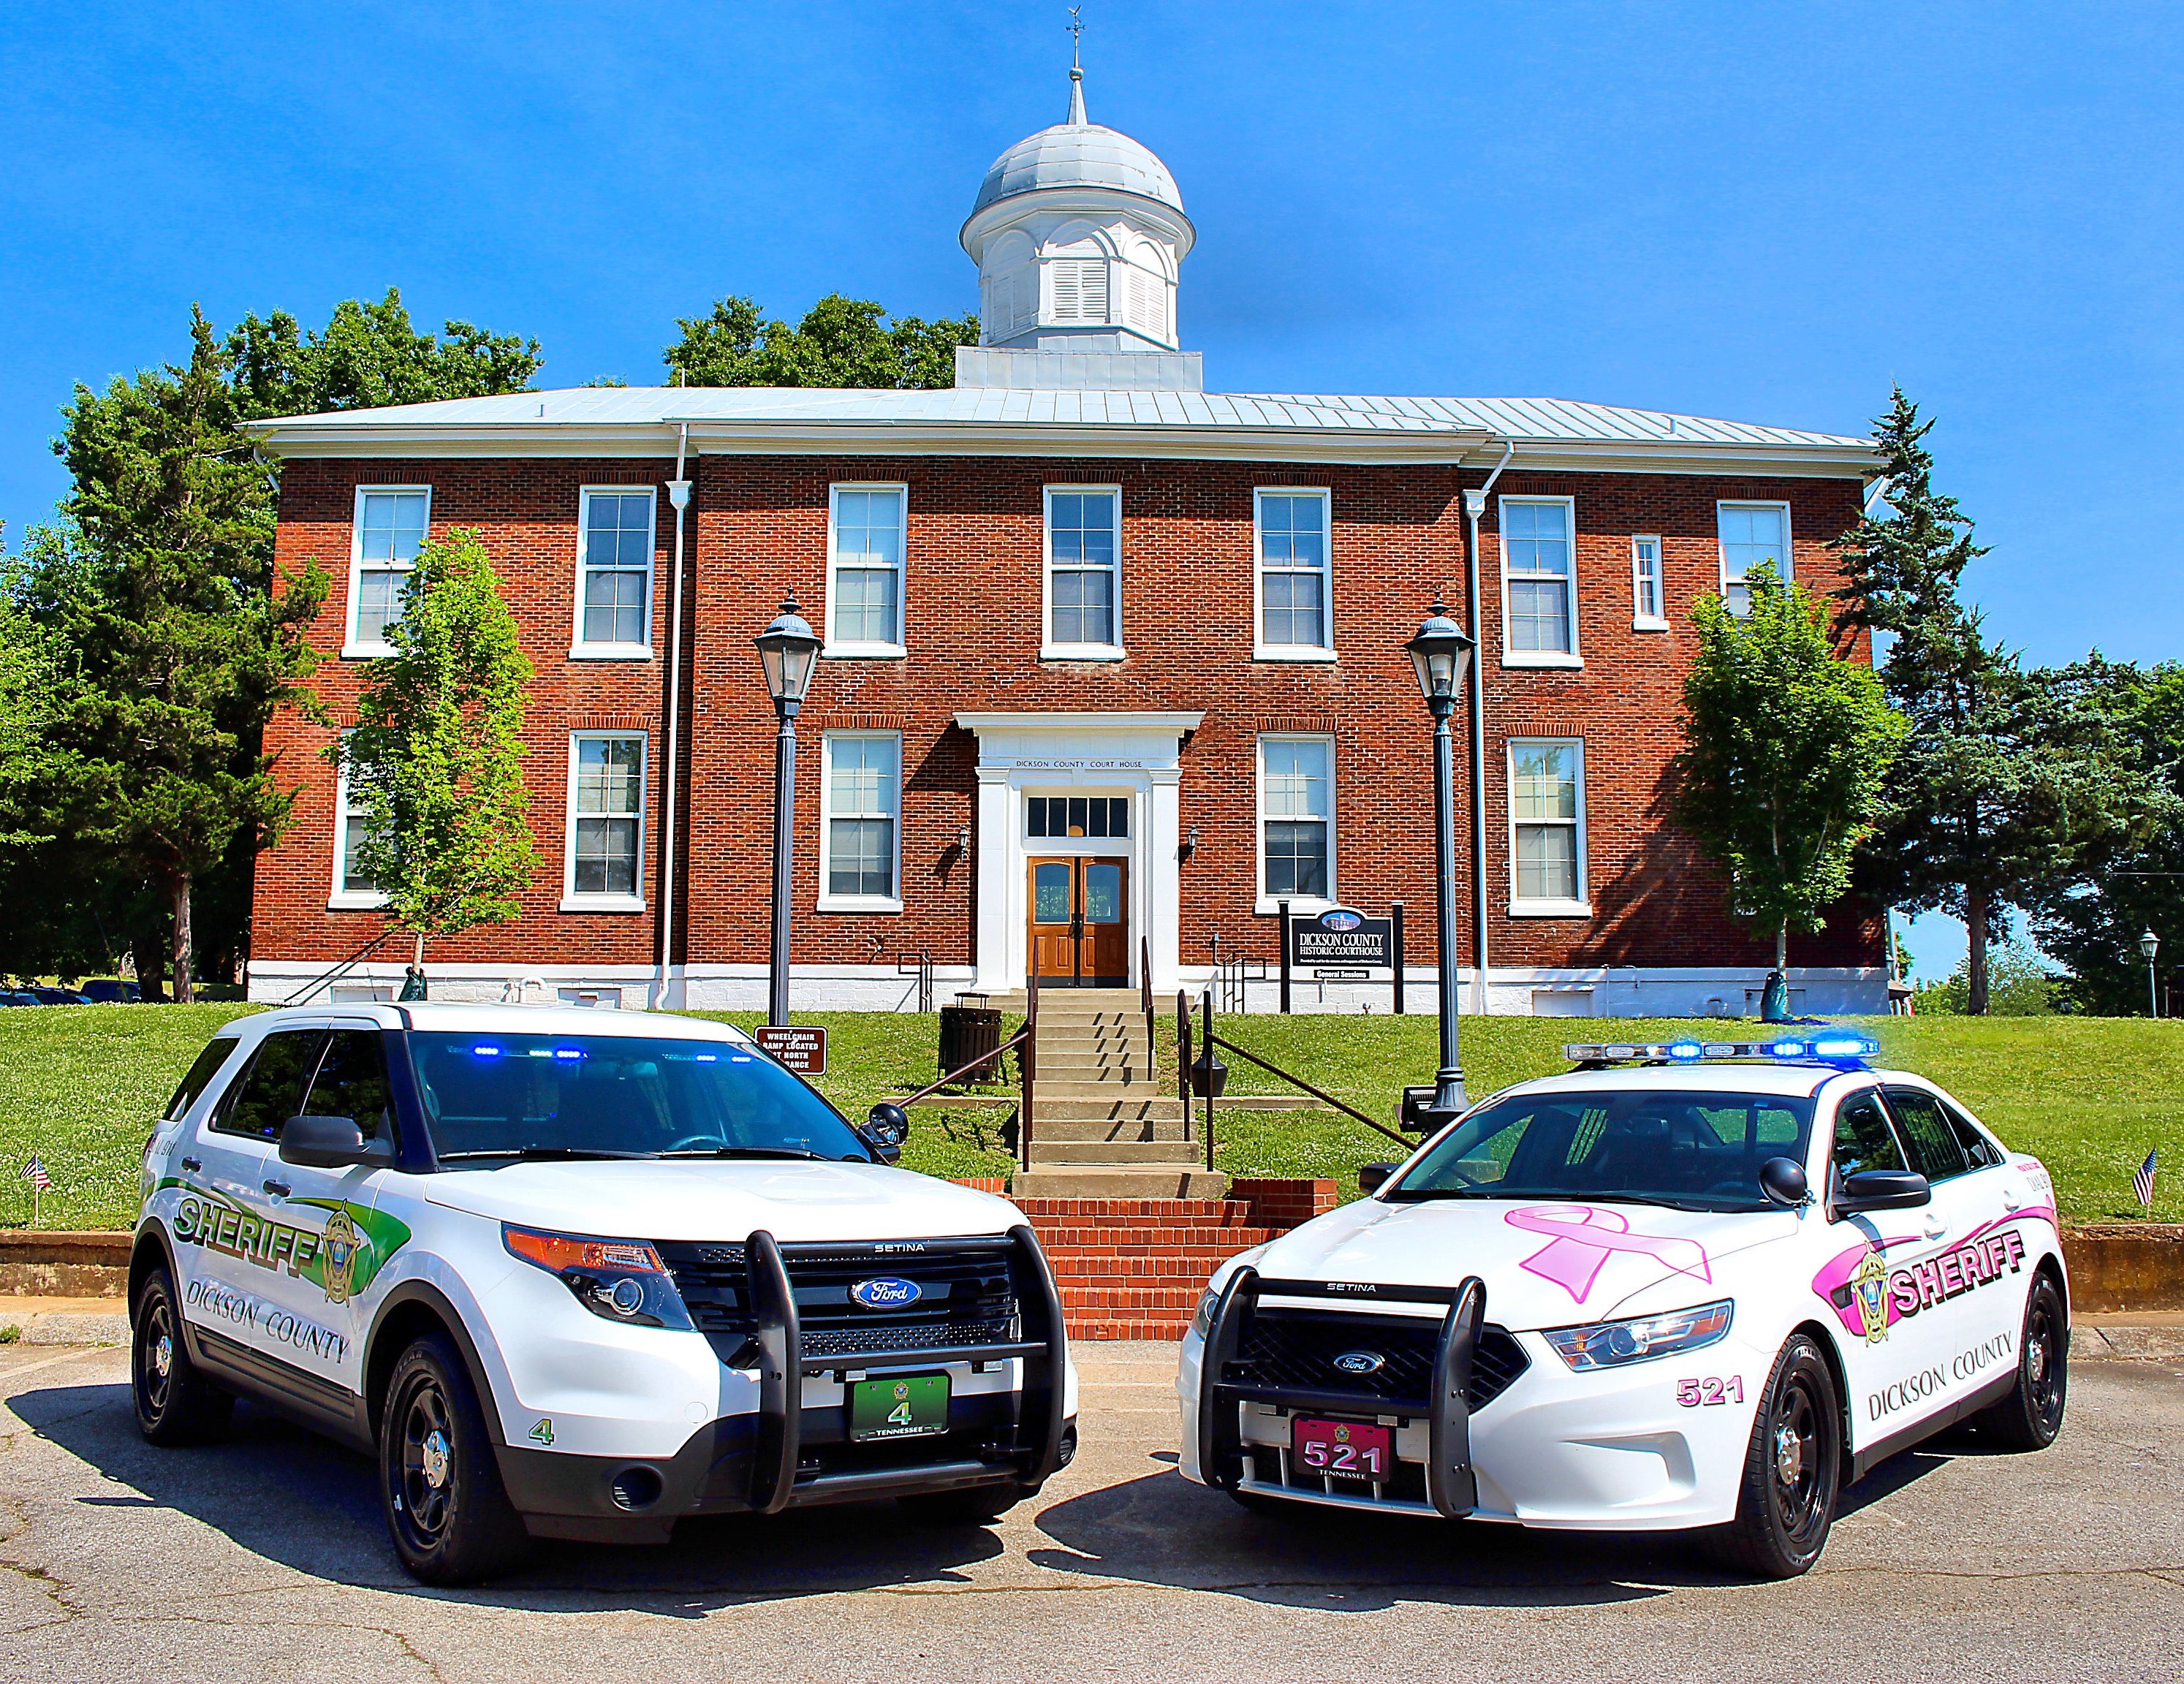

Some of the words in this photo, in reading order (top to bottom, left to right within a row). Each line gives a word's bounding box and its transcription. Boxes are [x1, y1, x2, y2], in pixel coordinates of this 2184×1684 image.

[1299, 933, 1341, 947] DICKSON
[1342, 933, 1384, 947] COUNTY
[1300, 947, 1335, 955] HISTORIC
[1335, 947, 1383, 956] COURTHOUSE
[1316, 970, 1340, 978] General
[767, 1033, 815, 1041] WHEELCHAIR
[786, 1042, 819, 1050] LOCATED
[161, 1140, 178, 1156] 911
[173, 1198, 322, 1278] SHERIFF
[874, 1243, 925, 1253] SETINA
[1889, 1229, 2025, 1317] SHERIFF
[871, 1282, 909, 1301] Ford
[1327, 1283, 1376, 1292] SETINA
[186, 1281, 260, 1330] DICKSON
[265, 1311, 350, 1364] COUNTY
[1342, 1357, 1367, 1370] Ford
[1868, 1363, 1947, 1422] DICKSON
[1953, 1330, 2012, 1380] COUNTY
[1676, 1375, 1744, 1408] 521
[887, 1401, 912, 1425] 4
[528, 1418, 555, 1446] 4
[876, 1426, 923, 1437] TENNESSEE
[1304, 1440, 1381, 1474] 521
[1319, 1469, 1367, 1480] TENNESSEE
